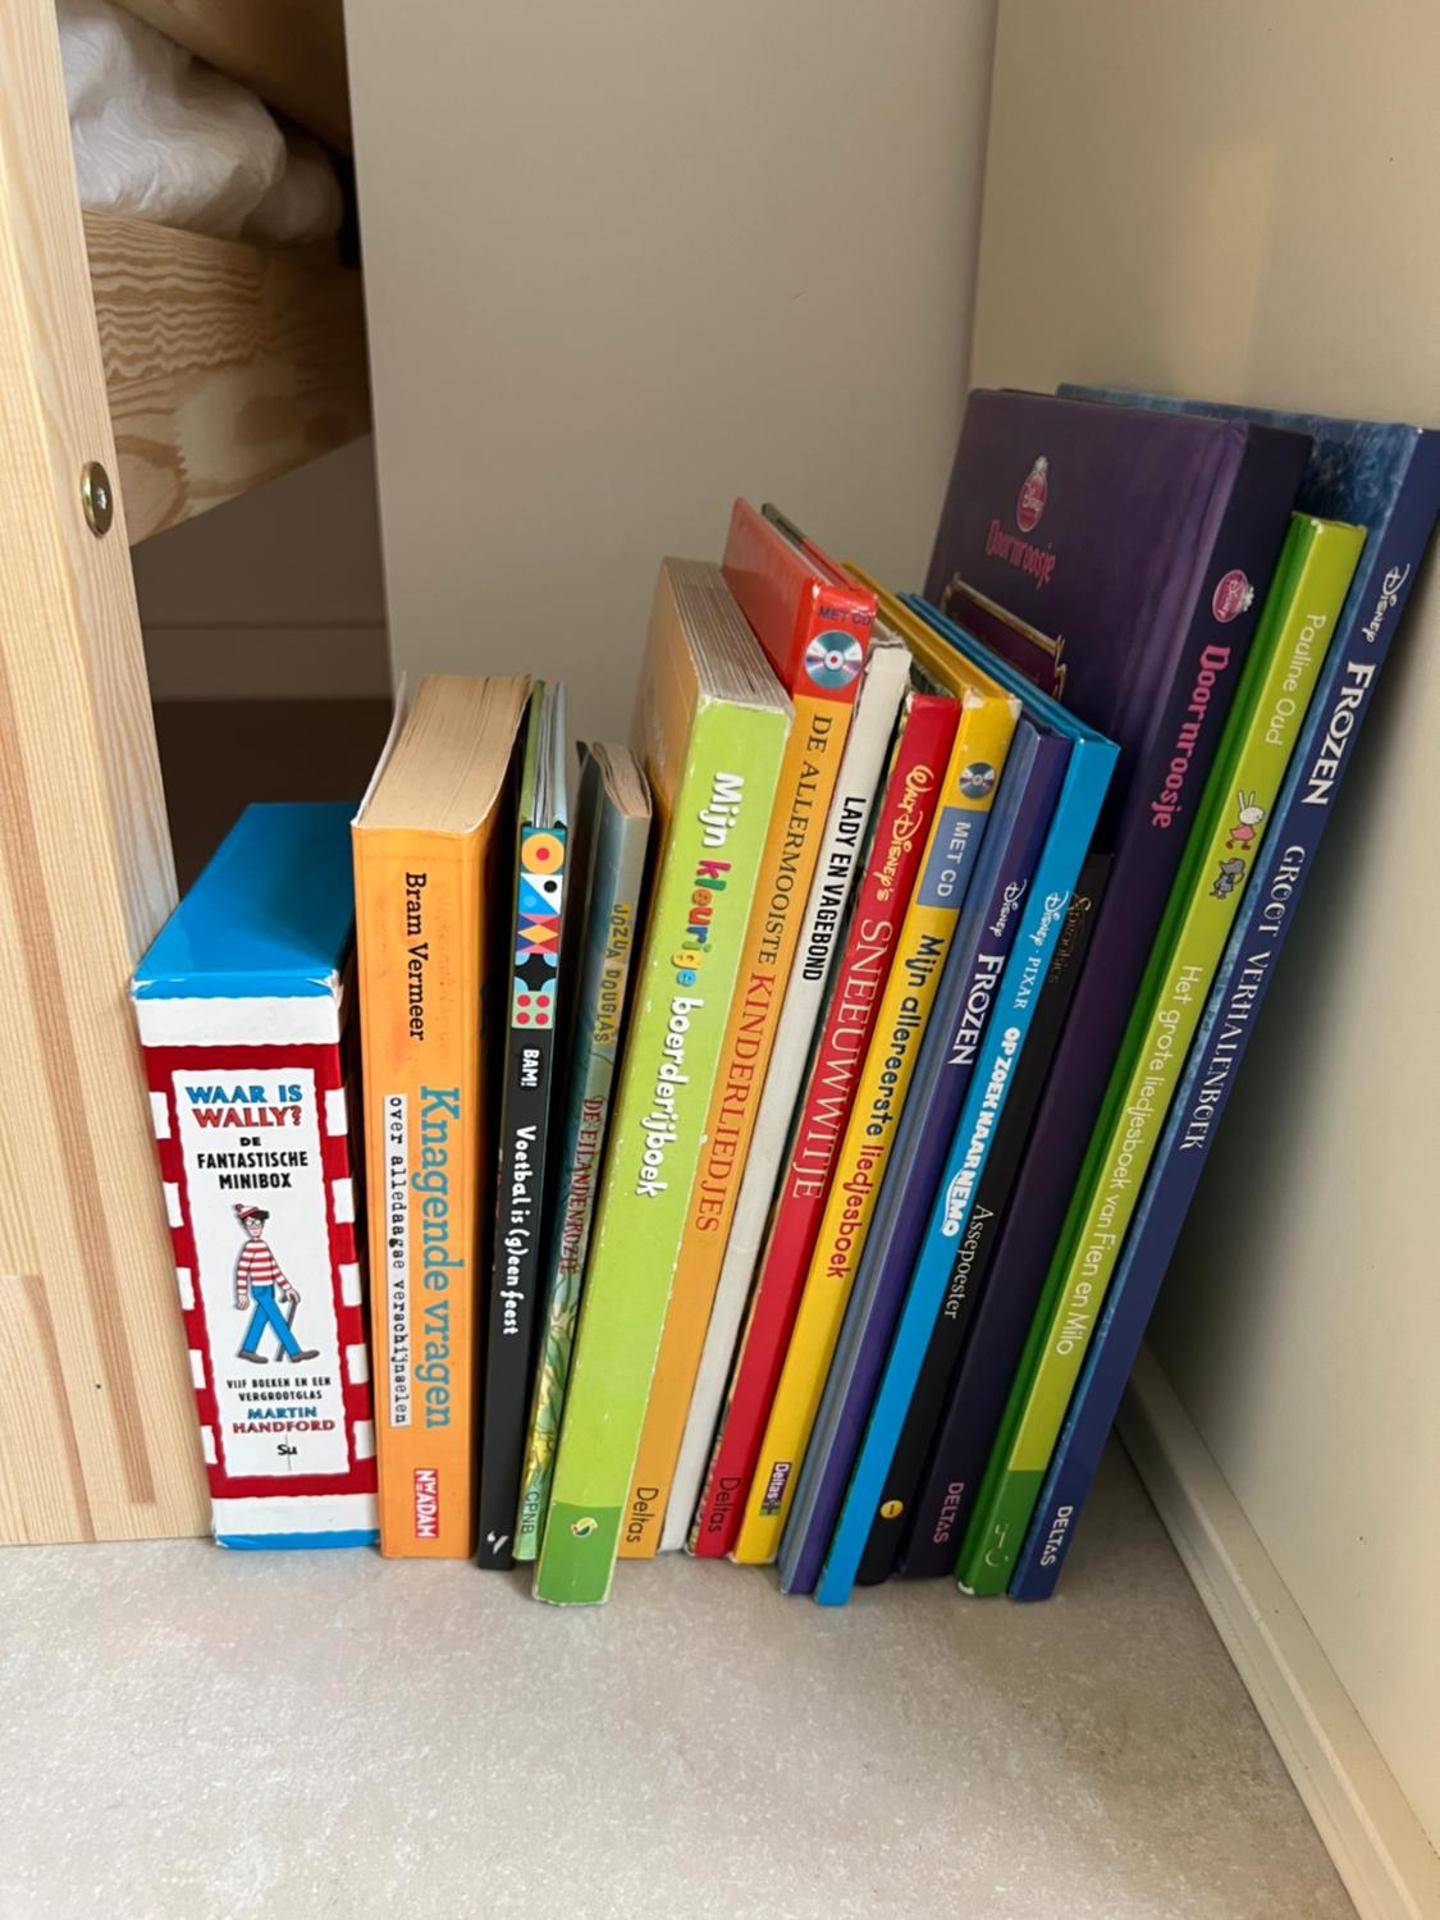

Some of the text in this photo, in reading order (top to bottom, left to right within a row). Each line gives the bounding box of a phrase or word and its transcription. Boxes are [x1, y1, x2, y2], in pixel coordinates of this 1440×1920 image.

[1265, 613, 1327, 745] Pauline Oud
[1152, 645, 1231, 829] Doornroosje
[898, 764, 935, 813] Walt
[803, 796, 867, 981] LADY EN VAGEBOND
[937, 822, 971, 897] MET CD
[1179, 563, 1411, 1150] Disney FROZEN GROOT VERHALENBOEK
[405, 872, 429, 1041] Bram Vermeer
[593, 904, 629, 1043] JOZUA DOUGLAS
[695, 714, 833, 1231] DE ALLERMOOISTE KINDERLIEDJES
[947, 879, 1028, 1065] Disney FROZEN
[1013, 890, 1070, 1009] Disney PIXAR
[636, 771, 745, 1197] Mijn kleurige boerderijboek
[521, 1048, 540, 1088] BAM!
[792, 919, 894, 1199] SNEEUWWITJE
[185, 1084, 303, 1104] WAAR IS
[192, 1105, 303, 1128] WALLY?
[583, 1098, 604, 1123] DE
[827, 934, 945, 1279] Mijn allereerste liedjesboek
[197, 1151, 309, 1169] FANTASTISCHE
[240, 1136, 262, 1147] DE
[941, 1027, 1021, 1237] OP ZOEK NAAR NEMO
[1056, 966, 1204, 1355] Het grote liedjesboek van Fien en Milo
[219, 1172, 293, 1190] MINIBOX
[389, 1096, 409, 1424] over alledaagse verschijnselen
[411, 1086, 465, 1430] Knagende vragen
[500, 1125, 537, 1335] Voetbal is (g)een feest
[944, 1204, 995, 1320] Assepoester
[227, 1376, 331, 1389] VIJF BOEKEN EN EEN
[238, 1390, 322, 1402] VERGROOTGLAS
[247, 1406, 318, 1420] MARTIN
[232, 1420, 336, 1434] HANDFORD
[277, 1443, 298, 1456] Su
[521, 1490, 540, 1535] CPNB
[625, 1486, 660, 1543] Deltas
[707, 1476, 742, 1534] Deltas
[767, 1462, 791, 1501] Deltas
[933, 1482, 965, 1544] DELTAS
[1040, 1505, 1074, 1566] DELTAS
